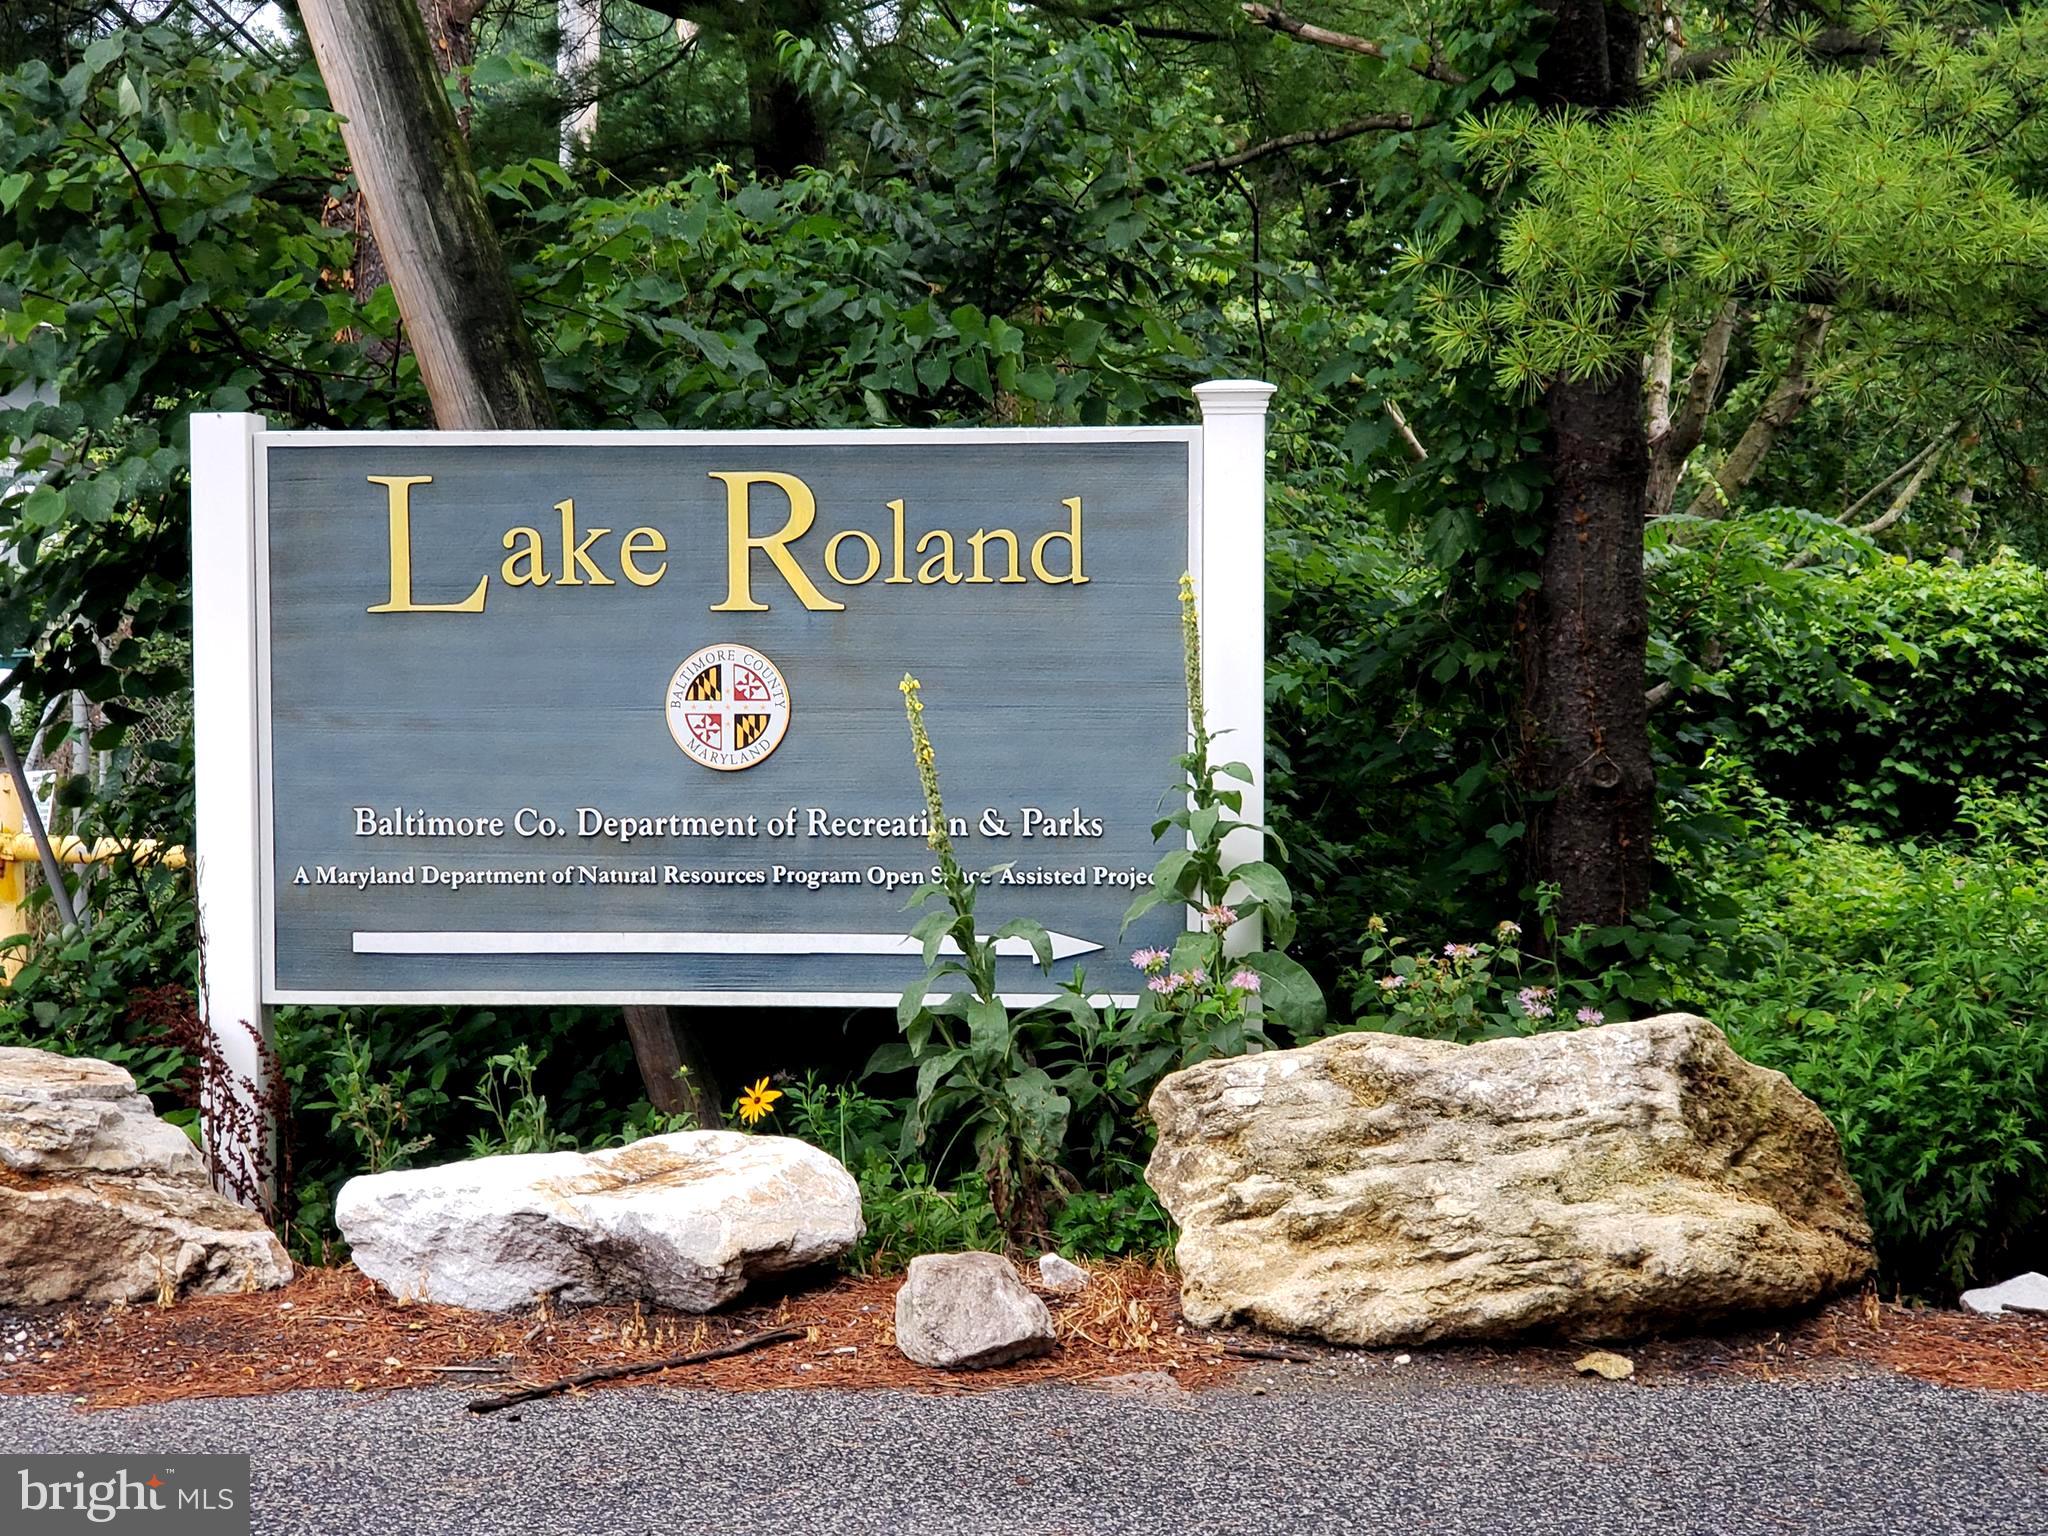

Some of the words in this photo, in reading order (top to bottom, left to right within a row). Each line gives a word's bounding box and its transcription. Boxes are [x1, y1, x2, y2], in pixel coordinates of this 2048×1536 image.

[367, 474, 668, 613] Lake
[708, 471, 1091, 612] Roland
[670, 649, 736, 709] BALTIMORE
[743, 654, 786, 709] COUNTY
[686, 738, 771, 765] MARYLAND
[353, 806, 504, 837] Baltimore
[513, 807, 565, 837] Co.
[576, 806, 758, 842] Department
[766, 806, 798, 837] of
[806, 807, 969, 837] Recreatin
[978, 807, 1011, 837] &
[1021, 807, 1103, 837] Parks
[293, 866, 310, 884] A
[315, 865, 415, 890] Maryland
[420, 865, 546, 890] Department
[551, 865, 573, 884] of
[577, 865, 657, 885] Natural
[663, 865, 766, 885] Resources
[771, 865, 861, 889] Program
[867, 866, 925, 890] Open
[930, 865, 992, 887] Sce
[999, 865, 1086, 885] Assisted
[1093, 866, 1156, 890] Projec
